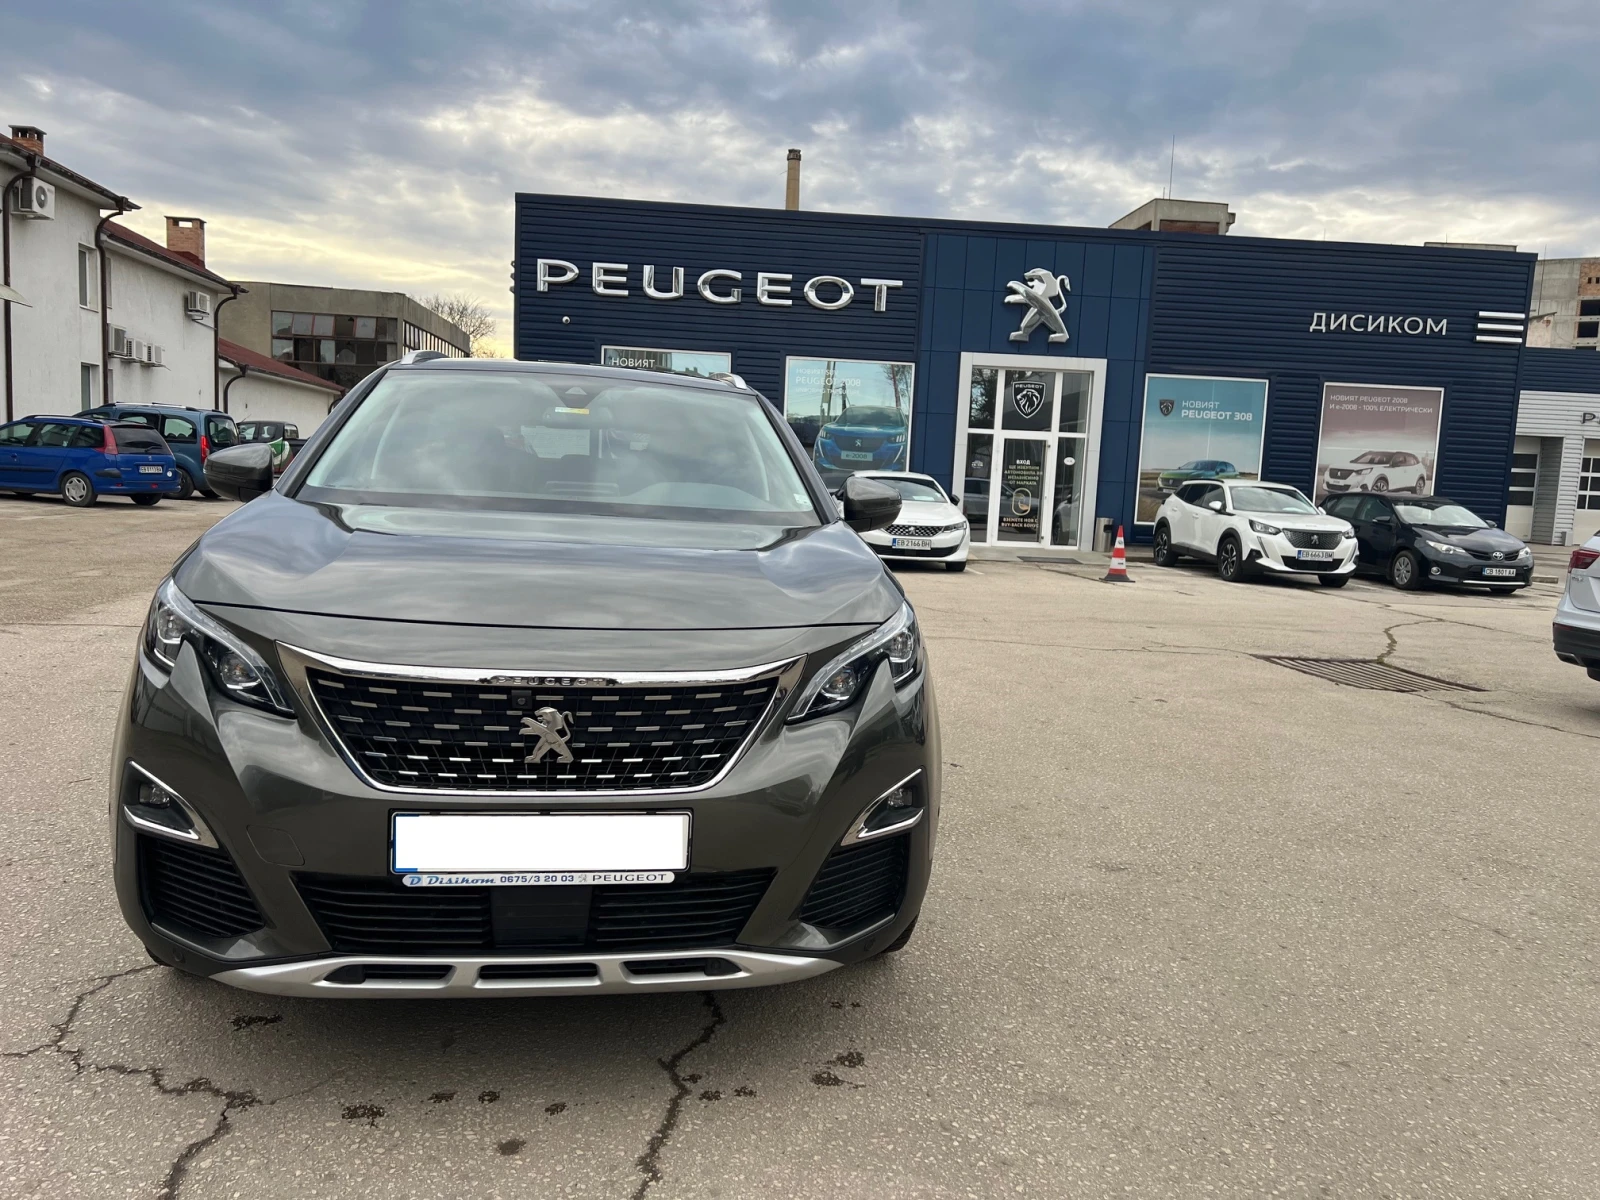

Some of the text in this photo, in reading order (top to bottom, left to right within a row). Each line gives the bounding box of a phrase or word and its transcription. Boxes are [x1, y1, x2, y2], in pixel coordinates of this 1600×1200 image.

[536, 258, 904, 312] PEUGEOT
[1309, 312, 1448, 336] ДИСИКОМ
[611, 357, 656, 368] НОВИЯТ
[795, 376, 838, 386] PEUGEOT
[1181, 400, 1220, 409] НОВИЯТ
[1359, 395, 1391, 403] PEUGEOT
[1380, 405, 1433, 413] ЕЛЕКТРИЧЕСКИ
[1181, 409, 1253, 421] PEUGEOT 308
[498, 676, 604, 687] PEUGEOT
[426, 875, 497, 886] Disikom
[500, 875, 541, 883] 0675/3
[560, 874, 575, 882] 03
[592, 873, 667, 882] PEUGEOT
